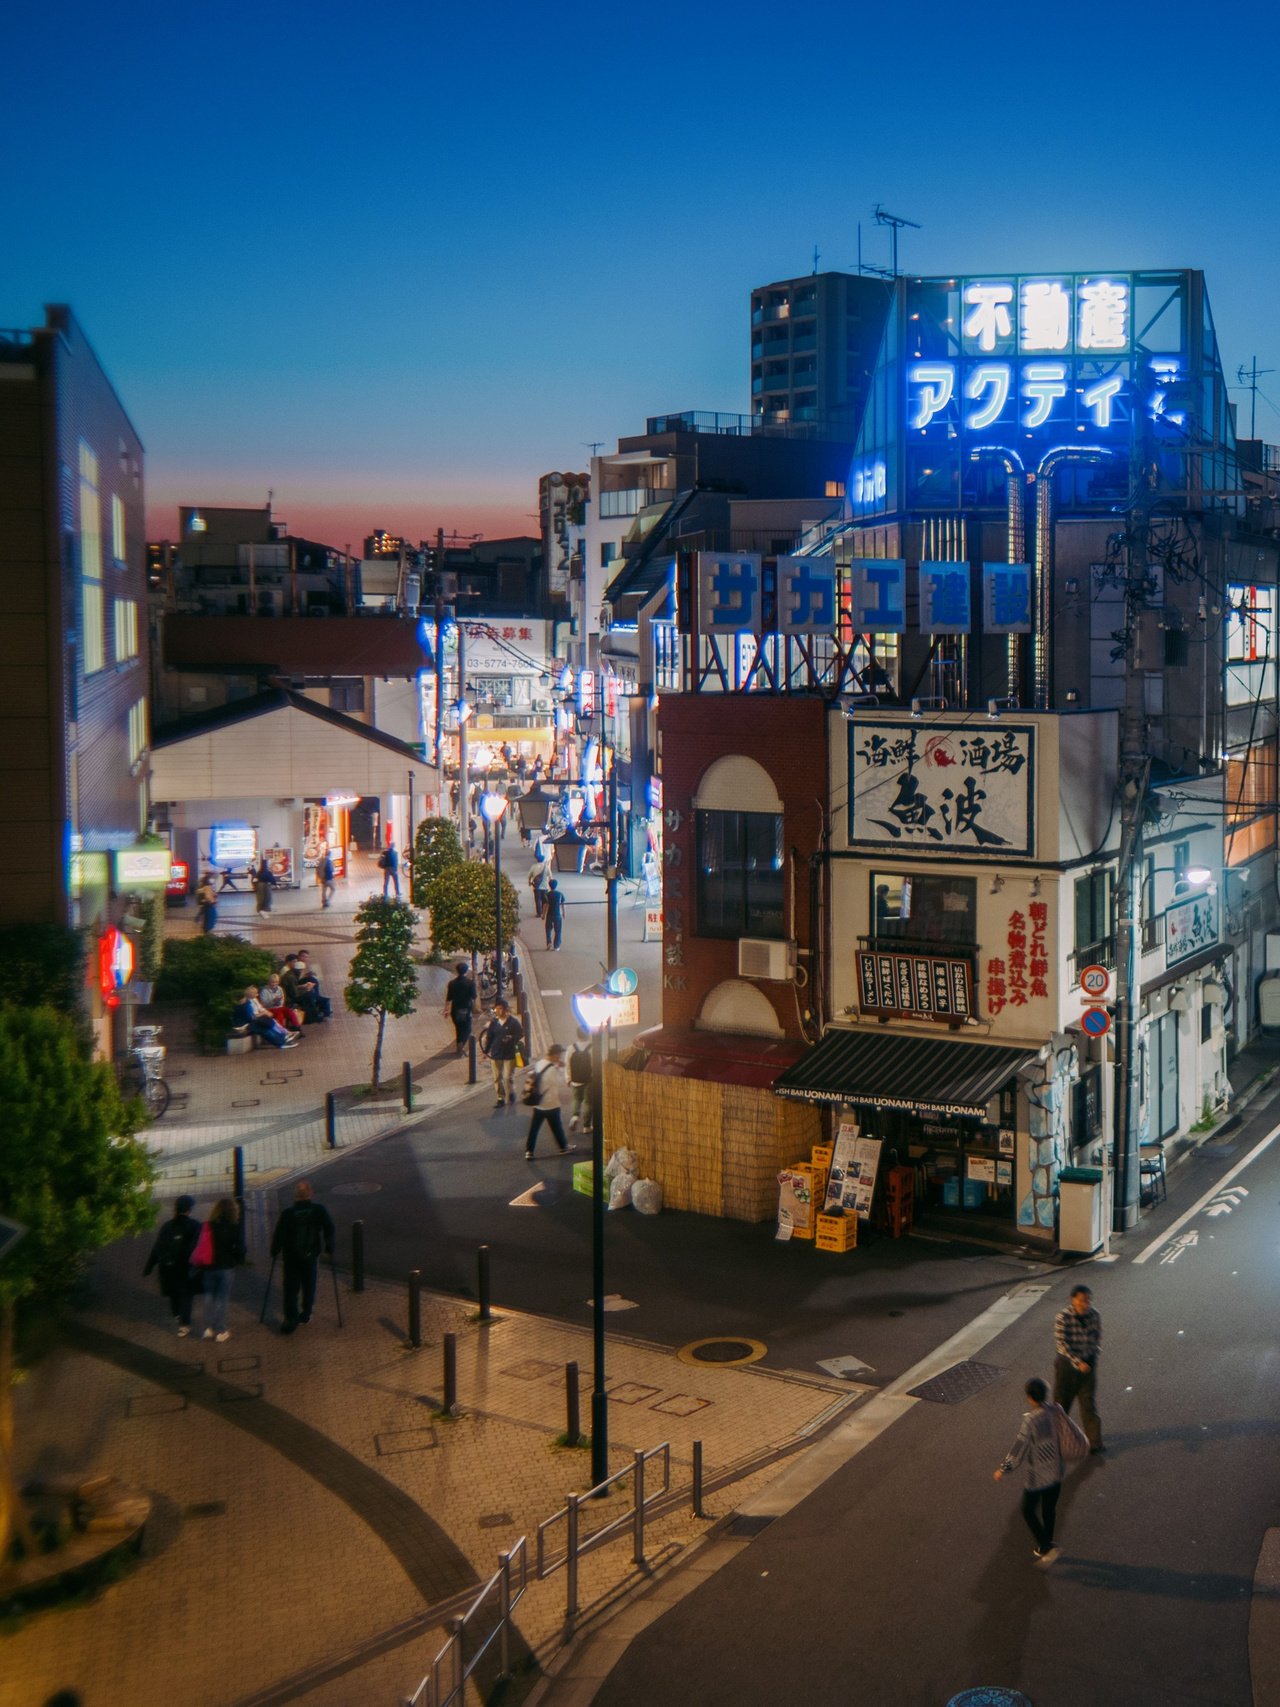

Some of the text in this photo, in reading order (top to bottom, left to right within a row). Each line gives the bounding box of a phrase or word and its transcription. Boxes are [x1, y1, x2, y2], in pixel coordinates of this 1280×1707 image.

[965, 281, 1128, 351] 不動産
[711, 563, 1030, 625] サカエ建設
[467, 659, 534, 668] 03-5774-750
[856, 729, 1026, 777] 海鮮 酒場
[866, 772, 1013, 846] 魚波
[1007, 909, 1028, 1006] 名物煮込み
[1029, 901, 1049, 998] 朝どれ鮮魚
[987, 957, 1007, 1015] 串揚げ
[1087, 974, 1104, 987] 20
[790, 1089, 804, 1097] BAR
[804, 1089, 843, 1102] UONAMI
[844, 1095, 859, 1103] FISH
[873, 1096, 914, 1109] UONAMI
[915, 1102, 930, 1110] FISH
[945, 1104, 986, 1117] UONAMI
